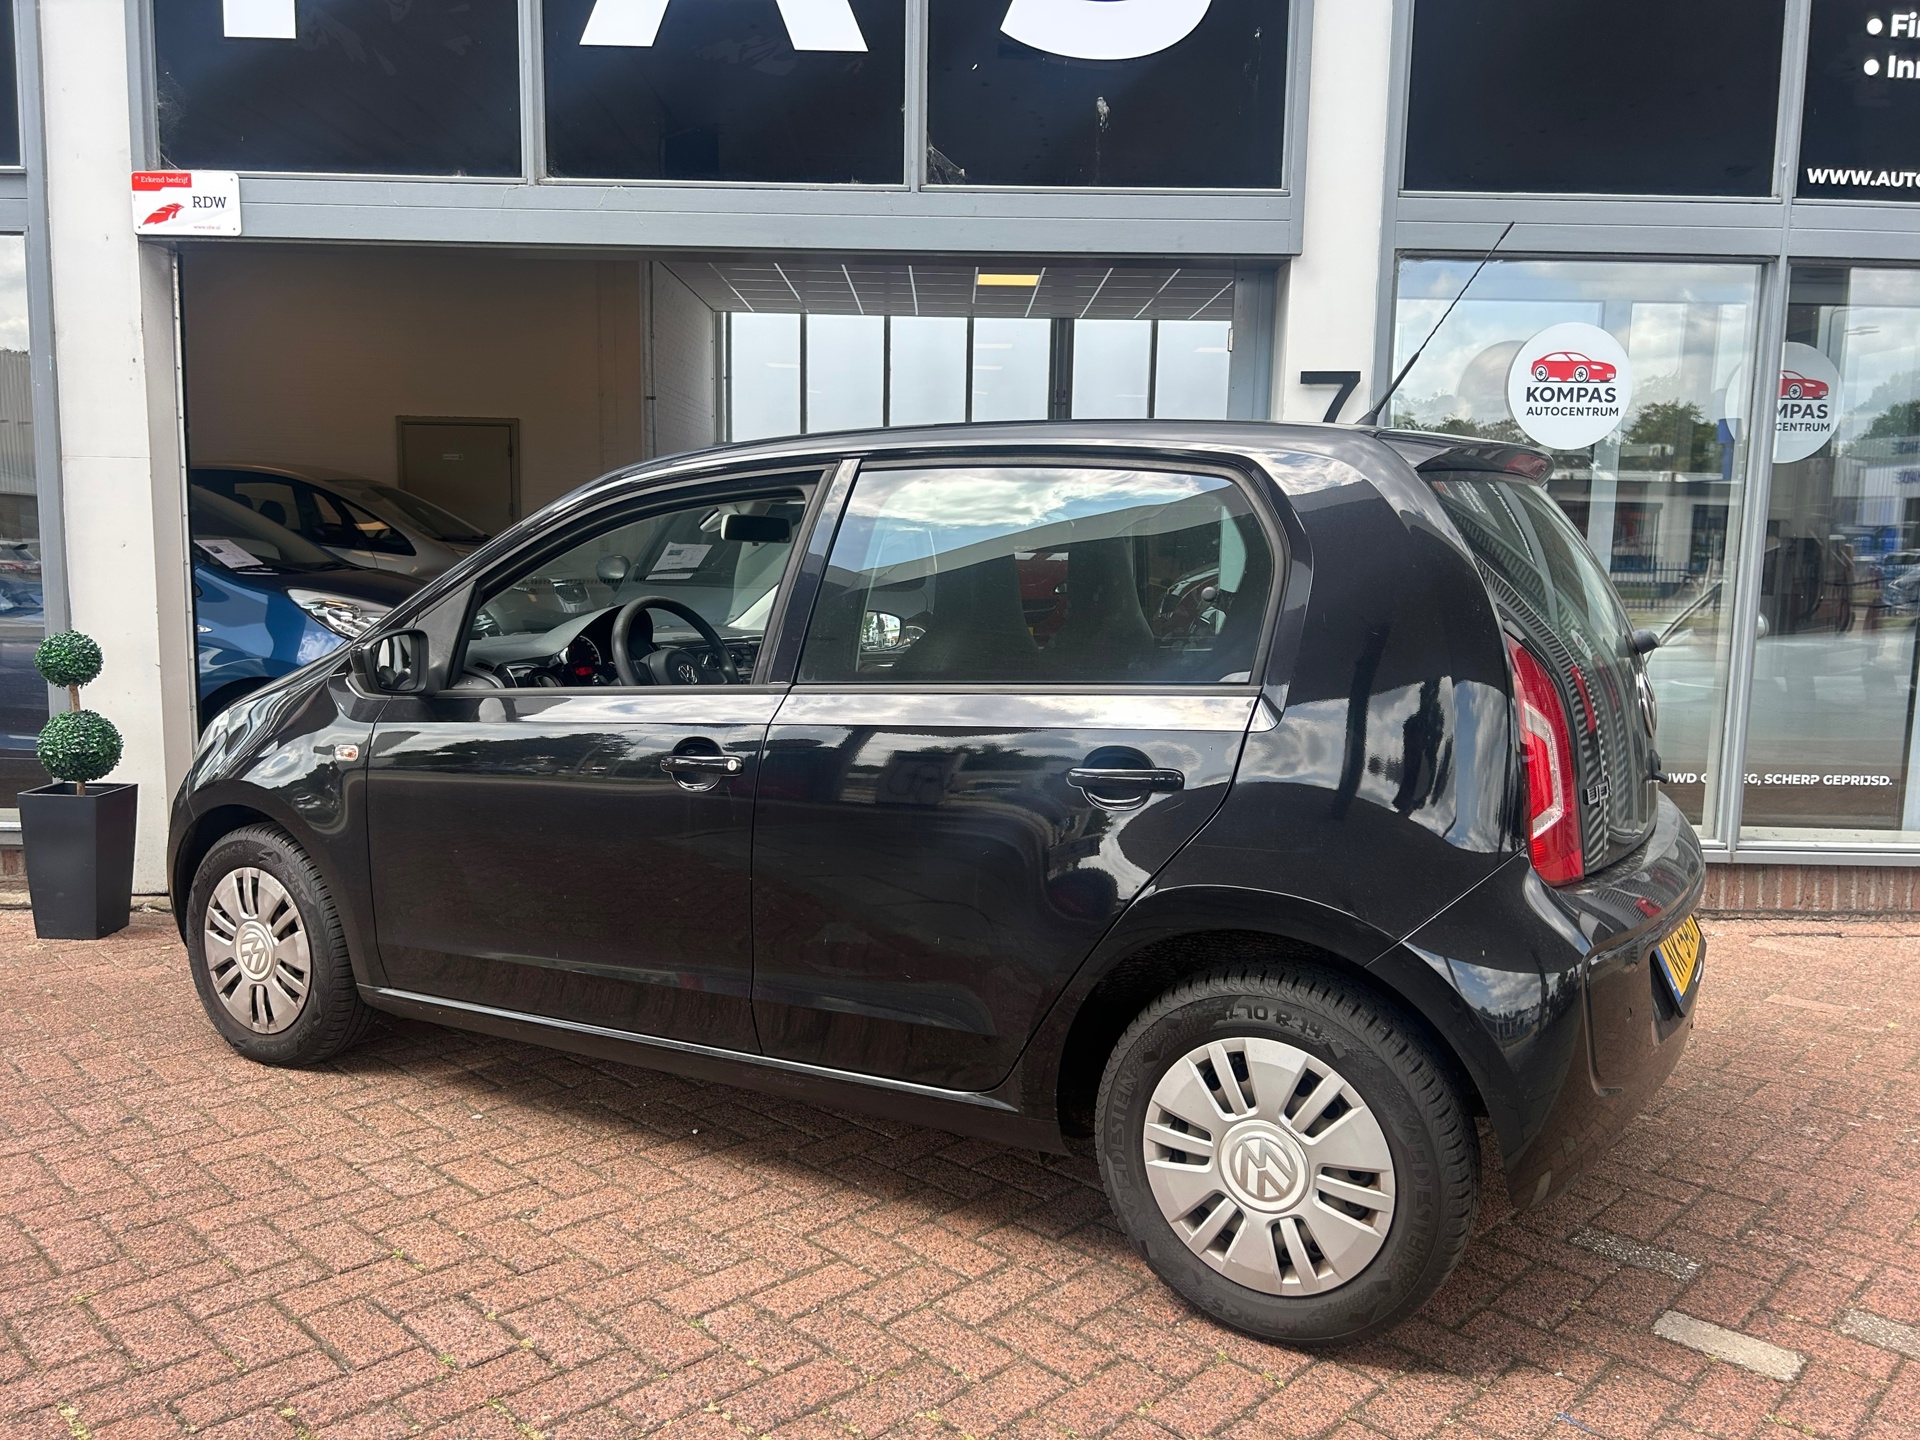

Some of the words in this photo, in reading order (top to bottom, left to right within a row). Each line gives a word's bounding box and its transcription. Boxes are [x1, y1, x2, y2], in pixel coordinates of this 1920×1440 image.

[1890, 12, 1920, 38] Fi
[1887, 55, 1920, 78] In
[166, 176, 189, 185] bedrijf
[192, 196, 227, 209] RDW
[1301, 371, 1361, 423] 7
[1526, 386, 1617, 404] KOMPAS
[1526, 406, 1619, 417] AUTOCENTRUM
[1778, 403, 1828, 419] MPAS
[1775, 422, 1830, 432] CENTRUM
[1764, 774, 1819, 785] SCHERP
[1822, 775, 1893, 786] GEPRIJSD.
